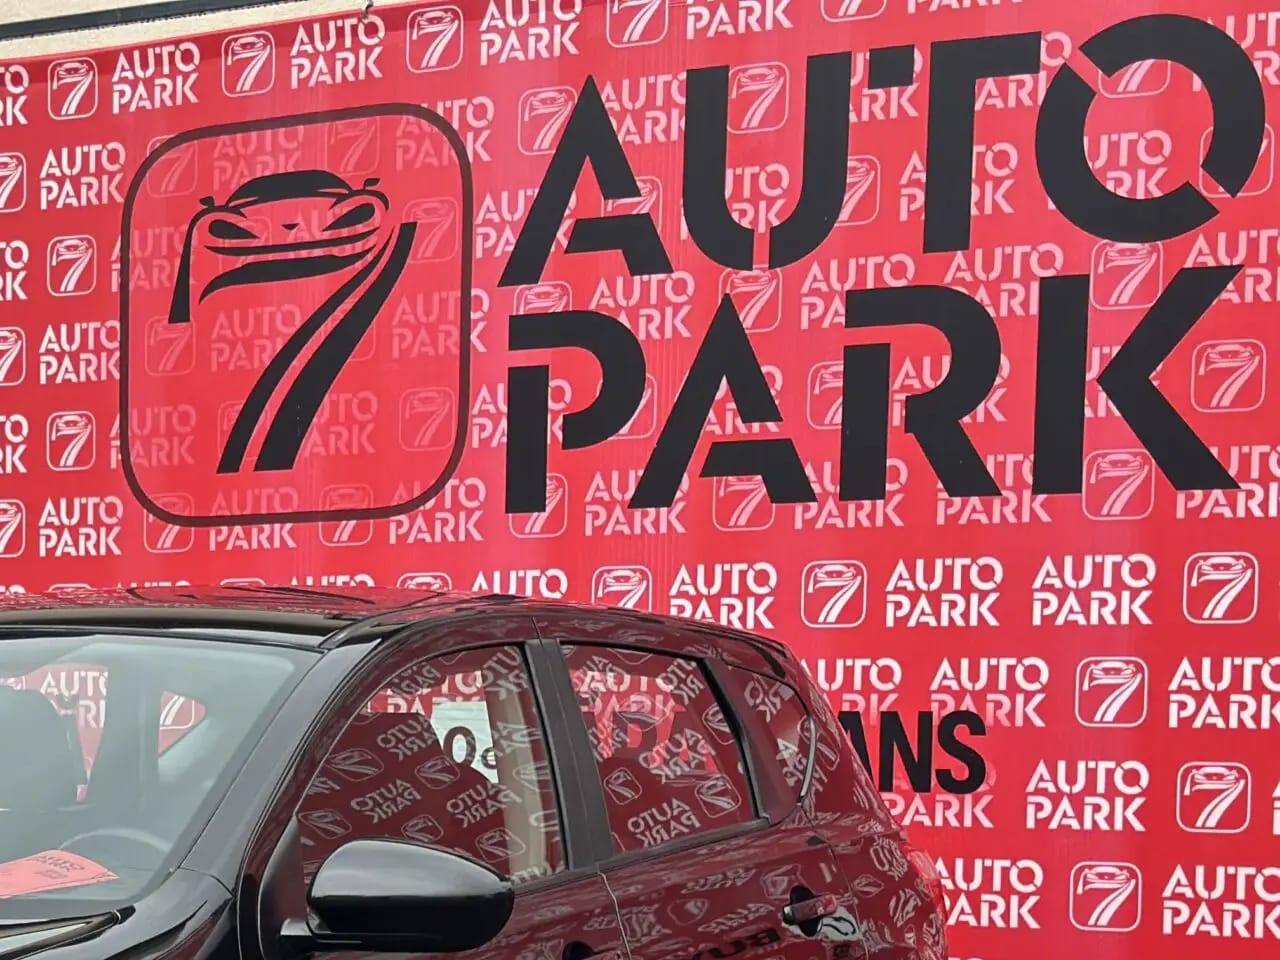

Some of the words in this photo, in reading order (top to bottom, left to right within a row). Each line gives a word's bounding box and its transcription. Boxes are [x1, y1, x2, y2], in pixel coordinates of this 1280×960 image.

[291, 16, 385, 56] AUTO
[686, 0, 794, 40] PARK
[113, 42, 200, 82] AUTO
[480, 22, 580, 66] PARK
[291, 46, 383, 89] PARK
[113, 73, 198, 114] PARK
[40, 142, 126, 179] AUTO
[497, 14, 1266, 287] AUTO
[40, 173, 124, 210] PARK
[944, 243, 1064, 283] AUTO
[1184, 228, 1280, 268] AUT
[590, 271, 695, 310] AUTO
[800, 253, 916, 294] AUTO
[39, 320, 120, 353] AUTO
[40, 350, 120, 384] PARK
[505, 265, 1245, 514] PARK
[38, 496, 123, 527] AUTO
[389, 511, 485, 544] PARK
[585, 502, 687, 536] PARK
[794, 493, 905, 529] PARK
[936, 493, 1052, 526] PARK
[39, 526, 122, 557] PARK
[472, 568, 568, 600] AUTO
[669, 562, 777, 596] AUTO
[885, 556, 1003, 592] AUTO
[1032, 553, 1156, 589] AUTO
[670, 597, 775, 629] PARK
[886, 592, 1000, 627] PARK
[1032, 590, 1152, 626] PARK
[930, 657, 1049, 691] AUTO
[1025, 759, 1149, 795] AUTO
[1026, 795, 1146, 832] PARK
[1162, 864, 1280, 902] AUTO
[943, 893, 1040, 929] ARK
[1163, 900, 1280, 940] PARK
